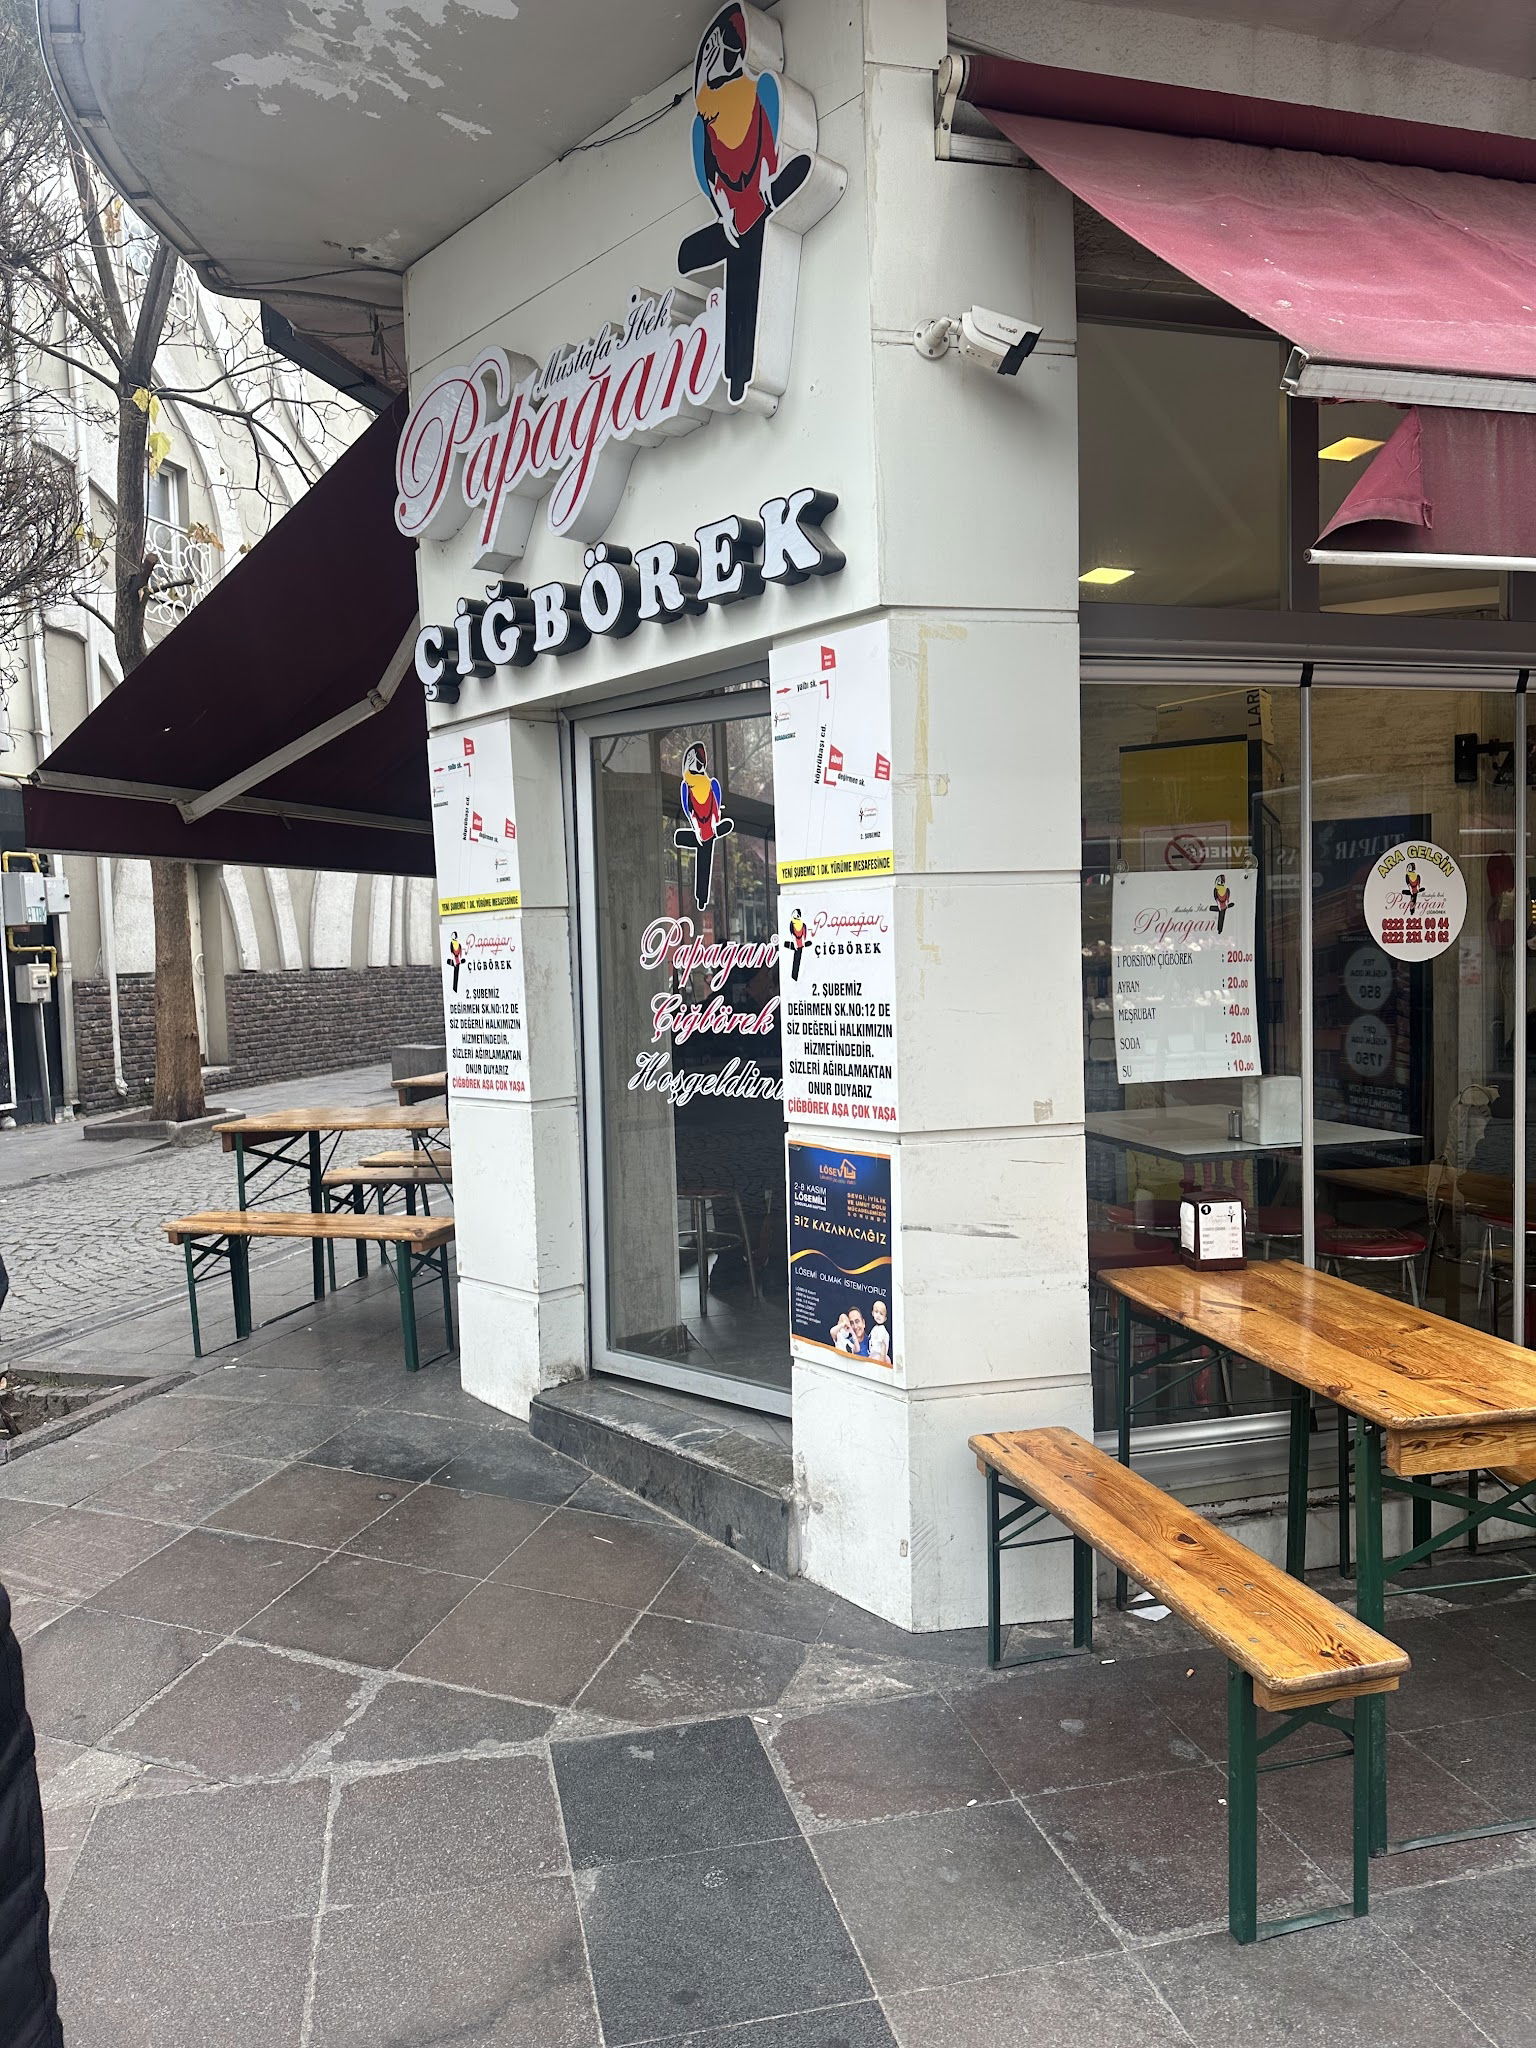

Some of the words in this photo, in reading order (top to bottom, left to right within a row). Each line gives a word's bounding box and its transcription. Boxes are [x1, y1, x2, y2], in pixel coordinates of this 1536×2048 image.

[536, 325, 615, 393] Mustafa
[399, 326, 721, 547] Papağan
[414, 487, 836, 704] ÇİĞBÖREK
[781, 865, 793, 879] YENİ
[793, 864, 816, 879] ŞUBEMİZ
[830, 860, 852, 874] YÜRÜME
[852, 856, 891, 873] MESAFESİNDE
[1377, 850, 1406, 878] ARA
[1406, 845, 1455, 877] GELSİN
[1382, 918, 1404, 930] 0222
[1437, 917, 1450, 930] 44
[1382, 931, 1404, 944] 0222
[640, 916, 779, 991] Papağan
[814, 941, 882, 959] ÇİĞBÖREK
[467, 959, 513, 974] ÇİĞBÖREK
[1122, 952, 1156, 967] PORSİYON
[1157, 950, 1193, 969] ÇİĞBÖREK
[465, 988, 472, 999] 2.
[473, 986, 500, 1000] ŞUBEMİZ
[812, 983, 820, 996] 2.
[822, 980, 863, 998] ŞUBEMİZ
[1117, 981, 1140, 993] AYRAN
[449, 1002, 480, 1015] DEĞİRMEN
[510, 1003, 519, 1014] DE
[787, 1000, 832, 1016] DEĞİRMEN
[834, 1003, 876, 1017] SK.NO:12
[878, 1003, 891, 1017] DE
[1118, 1007, 1157, 1024] MEŞRUBAT
[449, 1017, 459, 1029] SİZ
[460, 1017, 484, 1029] DEĞERLİ
[485, 1019, 521, 1030] HALKIMIZIN
[651, 992, 781, 1045] Çiğbörek
[786, 1019, 800, 1035] SİZ
[802, 1020, 837, 1036] DEĞERLİ
[839, 1023, 893, 1038] HALKIMIZIN
[461, 1032, 510, 1045] HİZMETİNDEDİR.
[1120, 1037, 1141, 1050] SODA
[452, 1046, 474, 1059] SİZLERİ
[475, 1047, 522, 1061] AĞIRLAMAKTAN
[804, 1039, 875, 1058] HİZMETİNDEDİR.
[465, 1063, 482, 1075] ONUR
[483, 1064, 509, 1075] DUYARIZ
[789, 1058, 820, 1075] SİZLERİ
[822, 1060, 892, 1079] AĞIRLAMAKTAN
[1122, 1065, 1132, 1078] SU
[452, 1076, 481, 1089] ÇİĞBÖREK
[495, 1080, 508, 1091] ÇOK
[508, 1080, 526, 1093] YAŞA
[628, 1051, 784, 1106] Hoşgeldini
[808, 1081, 832, 1096] ONUR
[834, 1083, 873, 1099] DUYARIZ
[788, 1097, 830, 1115] ÇİĞBÖREK
[831, 1102, 850, 1119] AŞA
[851, 1103, 870, 1119] ÇOK
[872, 1105, 897, 1122] YAŞA
[794, 1182, 805, 1191] 2-8
[806, 1184, 827, 1196] KASIM
[794, 1191, 827, 1206] LÖSEMİLİ
[794, 1215, 809, 1228] BİZ
[812, 1219, 887, 1245] KAZANACAĞIZ
[794, 1266, 818, 1279] LÖSEMİ
[819, 1273, 842, 1286] OLMAK
[844, 1277, 887, 1297] İSTEMİYORUZ
